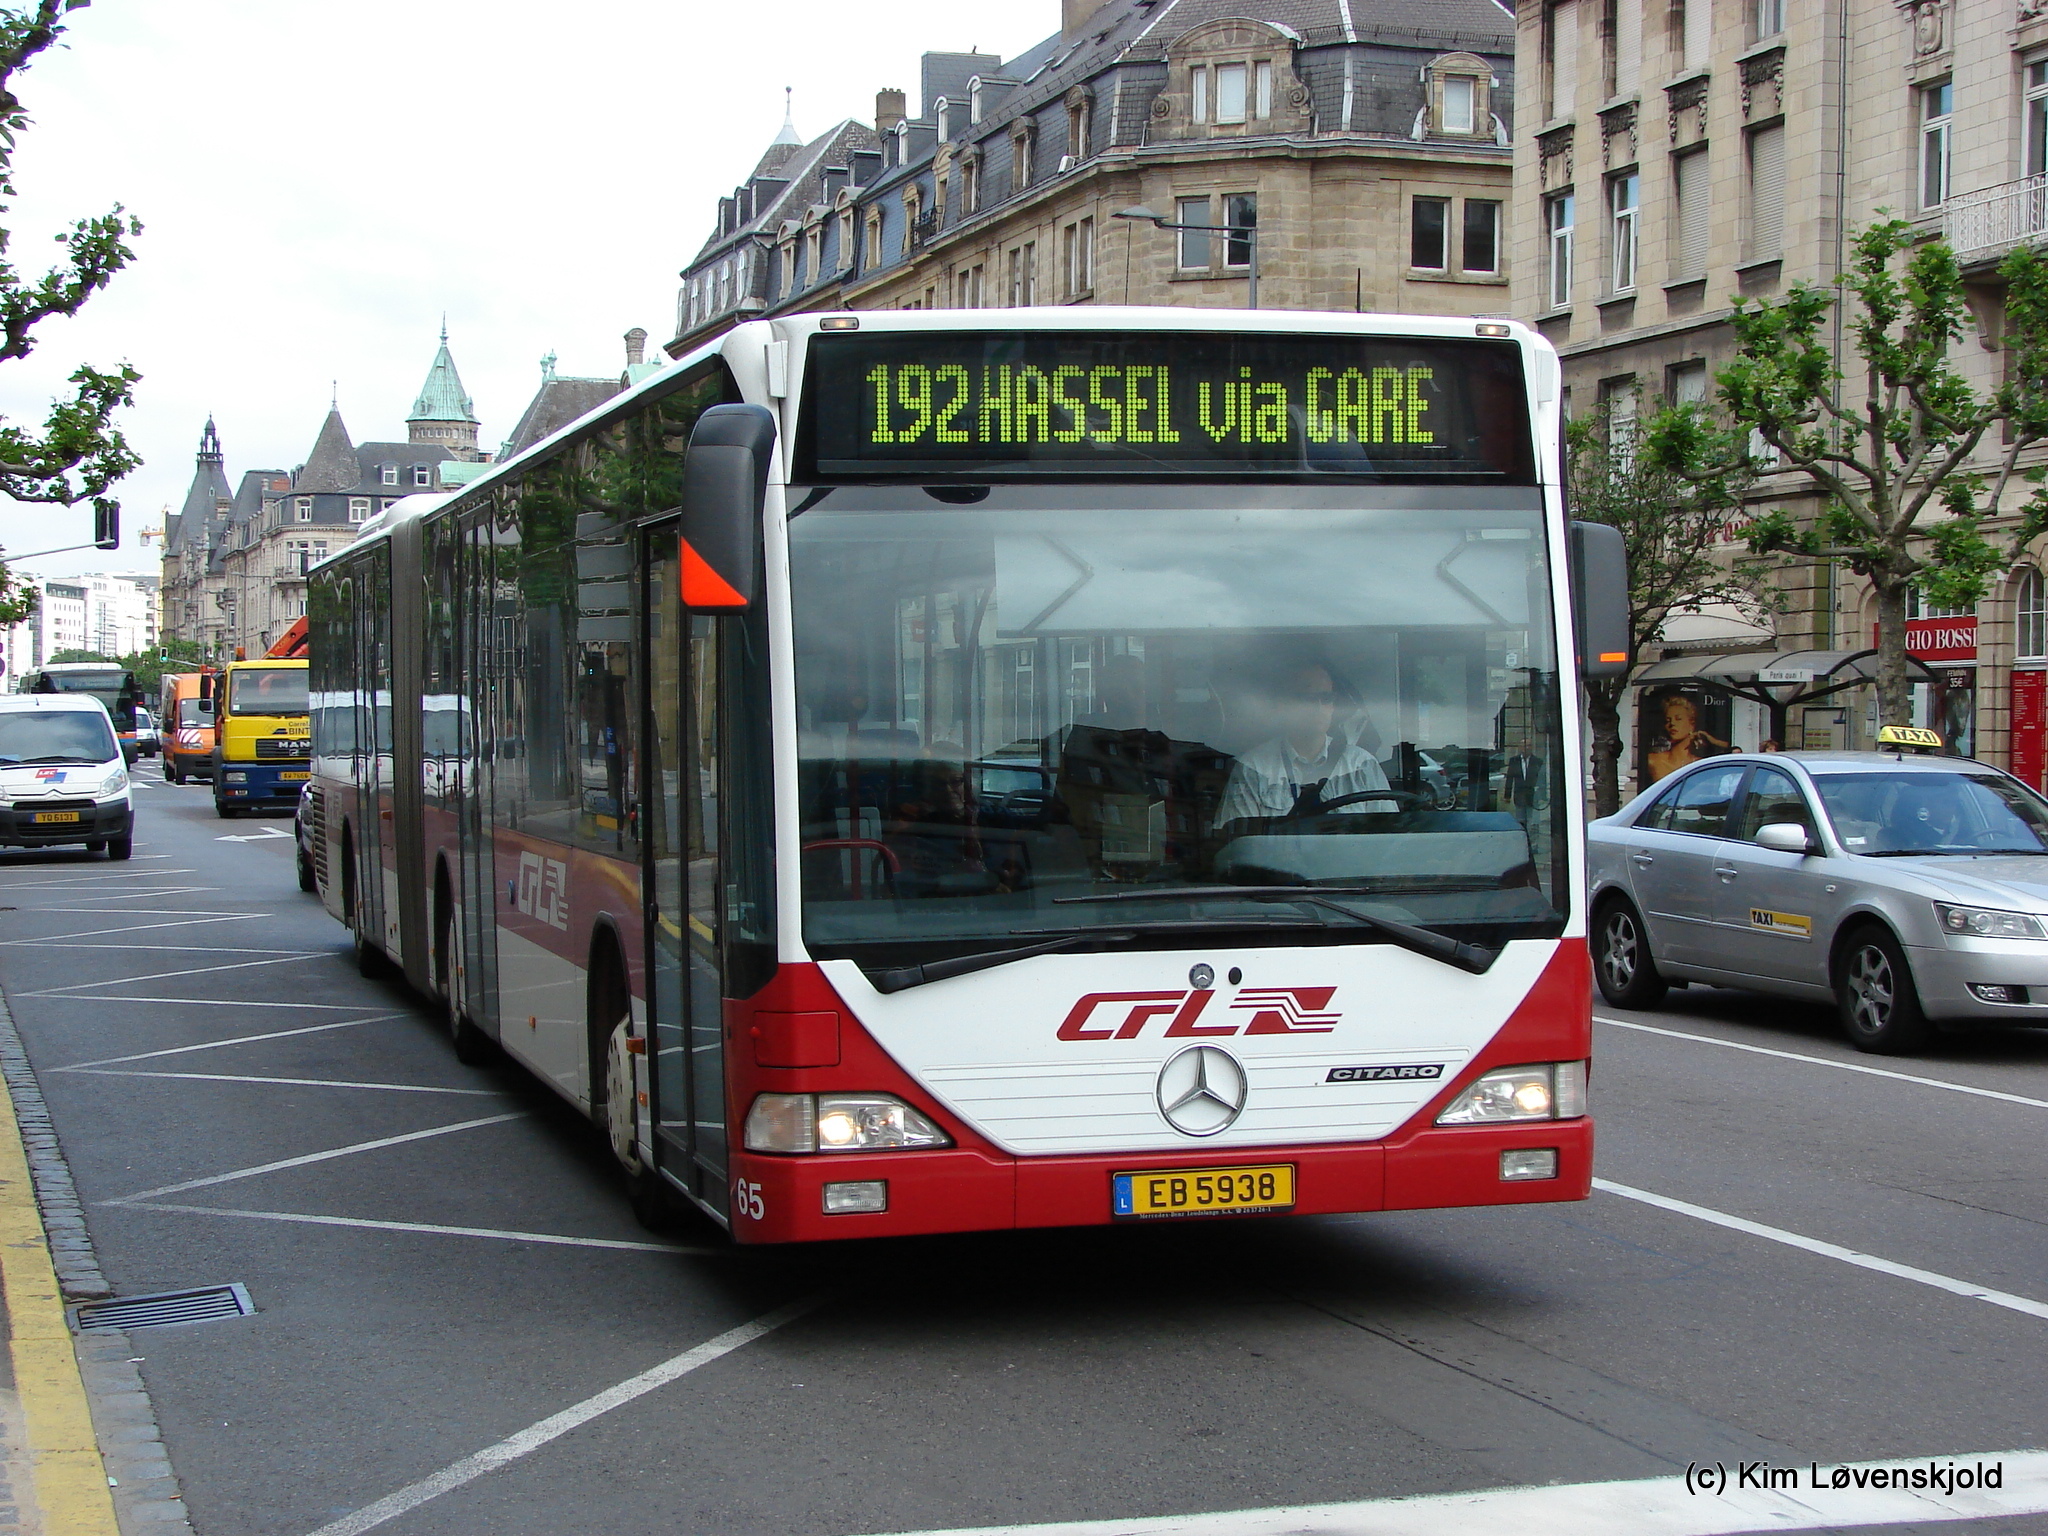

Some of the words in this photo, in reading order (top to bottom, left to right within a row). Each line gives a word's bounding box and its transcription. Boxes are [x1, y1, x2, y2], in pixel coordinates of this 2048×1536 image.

[866, 364, 969, 443] 192
[978, 364, 1180, 443] HASSEL
[1199, 366, 1287, 443] via
[1306, 366, 1434, 443] GARE
[1904, 630, 1933, 650] GIO
[1704, 694, 1726, 706] Dior
[1890, 728, 1938, 744] TAXI
[1751, 910, 1773, 926] TAXI
[1056, 989, 1241, 1042] CFL
[1332, 1066, 1440, 1081] CITARO
[737, 1177, 765, 1220] 65
[1120, 1197, 1128, 1209] L
[1150, 1178, 1188, 1208] EB
[1196, 1172, 1276, 1205] 5938
